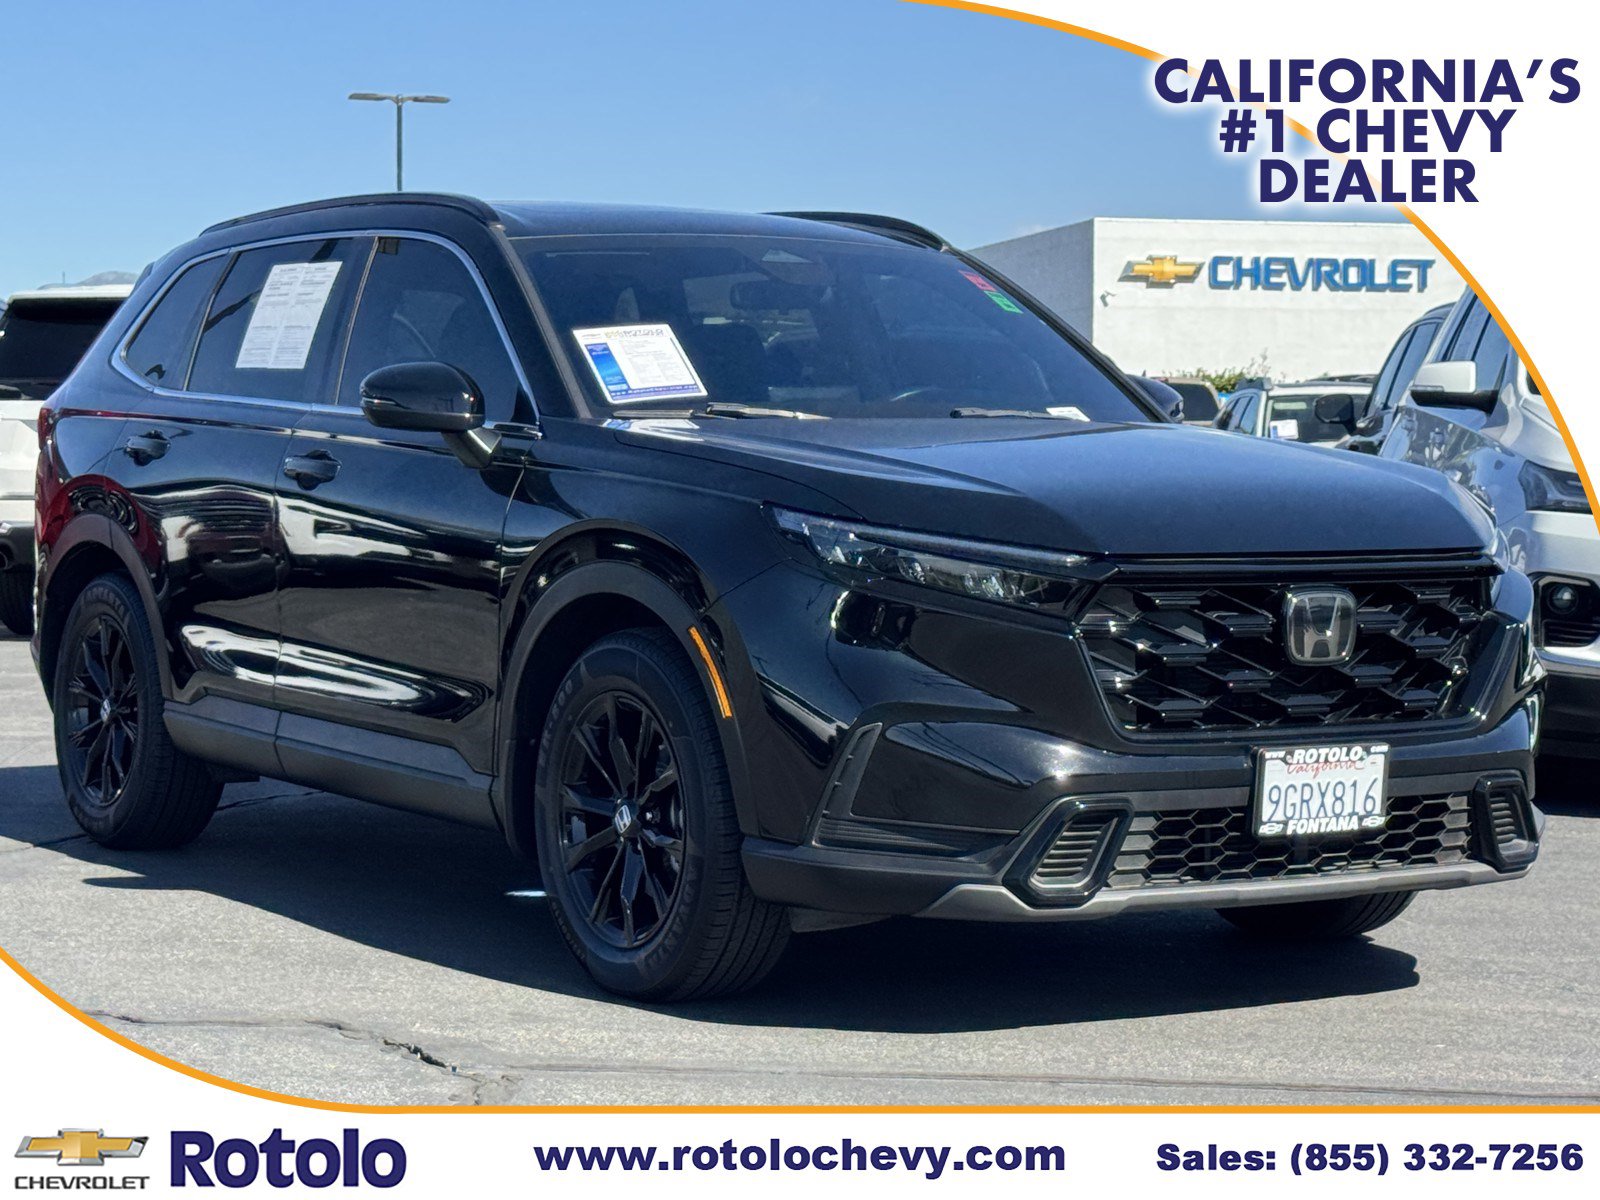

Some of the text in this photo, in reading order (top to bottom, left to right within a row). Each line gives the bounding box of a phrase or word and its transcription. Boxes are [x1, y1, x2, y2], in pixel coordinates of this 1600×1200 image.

[1208, 256, 1436, 293] CHEVROLET
[1292, 746, 1363, 764] ROTOLO
[1268, 777, 1379, 822] 9GRX816
[1286, 815, 1359, 836] FONTANA
